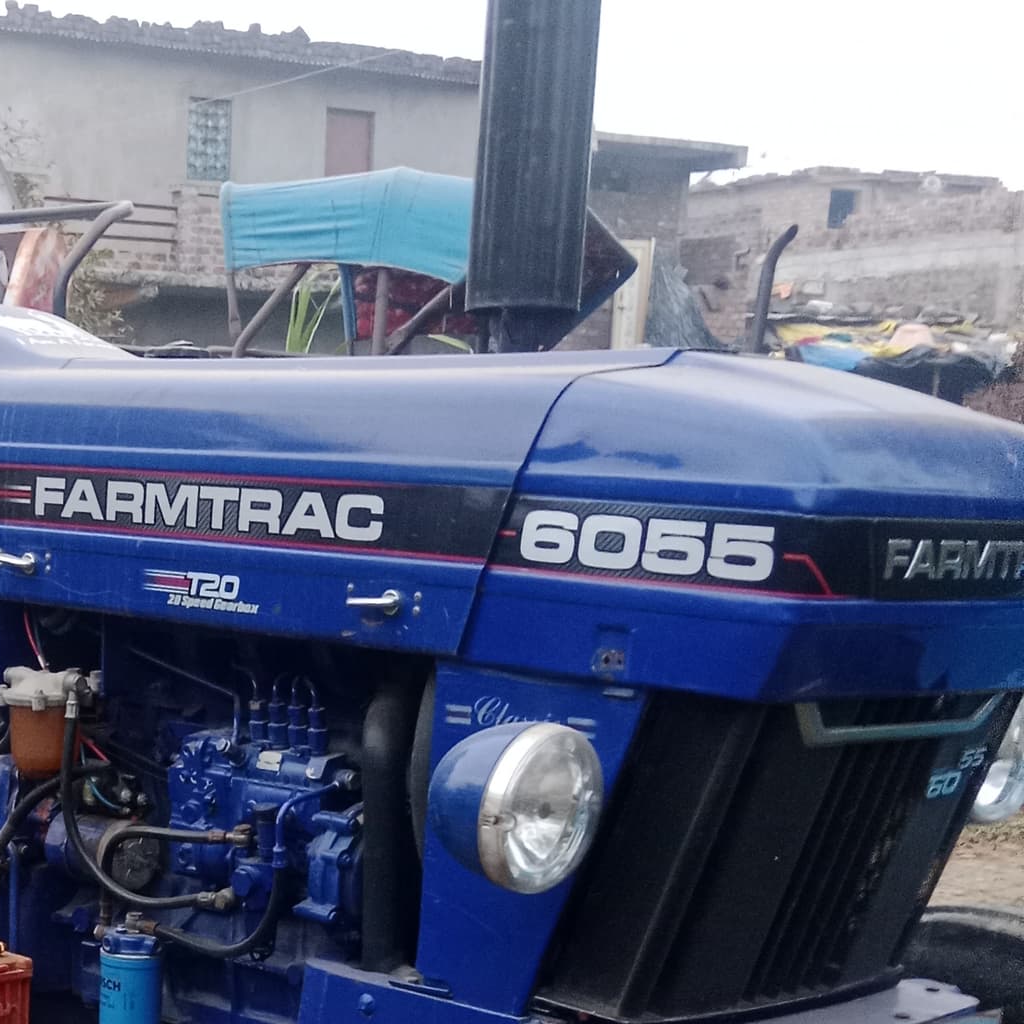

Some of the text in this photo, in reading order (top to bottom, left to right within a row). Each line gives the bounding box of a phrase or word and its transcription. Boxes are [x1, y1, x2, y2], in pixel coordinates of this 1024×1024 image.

[33, 476, 385, 543] FARMTRAC
[520, 510, 776, 582] 6055
[186, 571, 241, 600] T20
